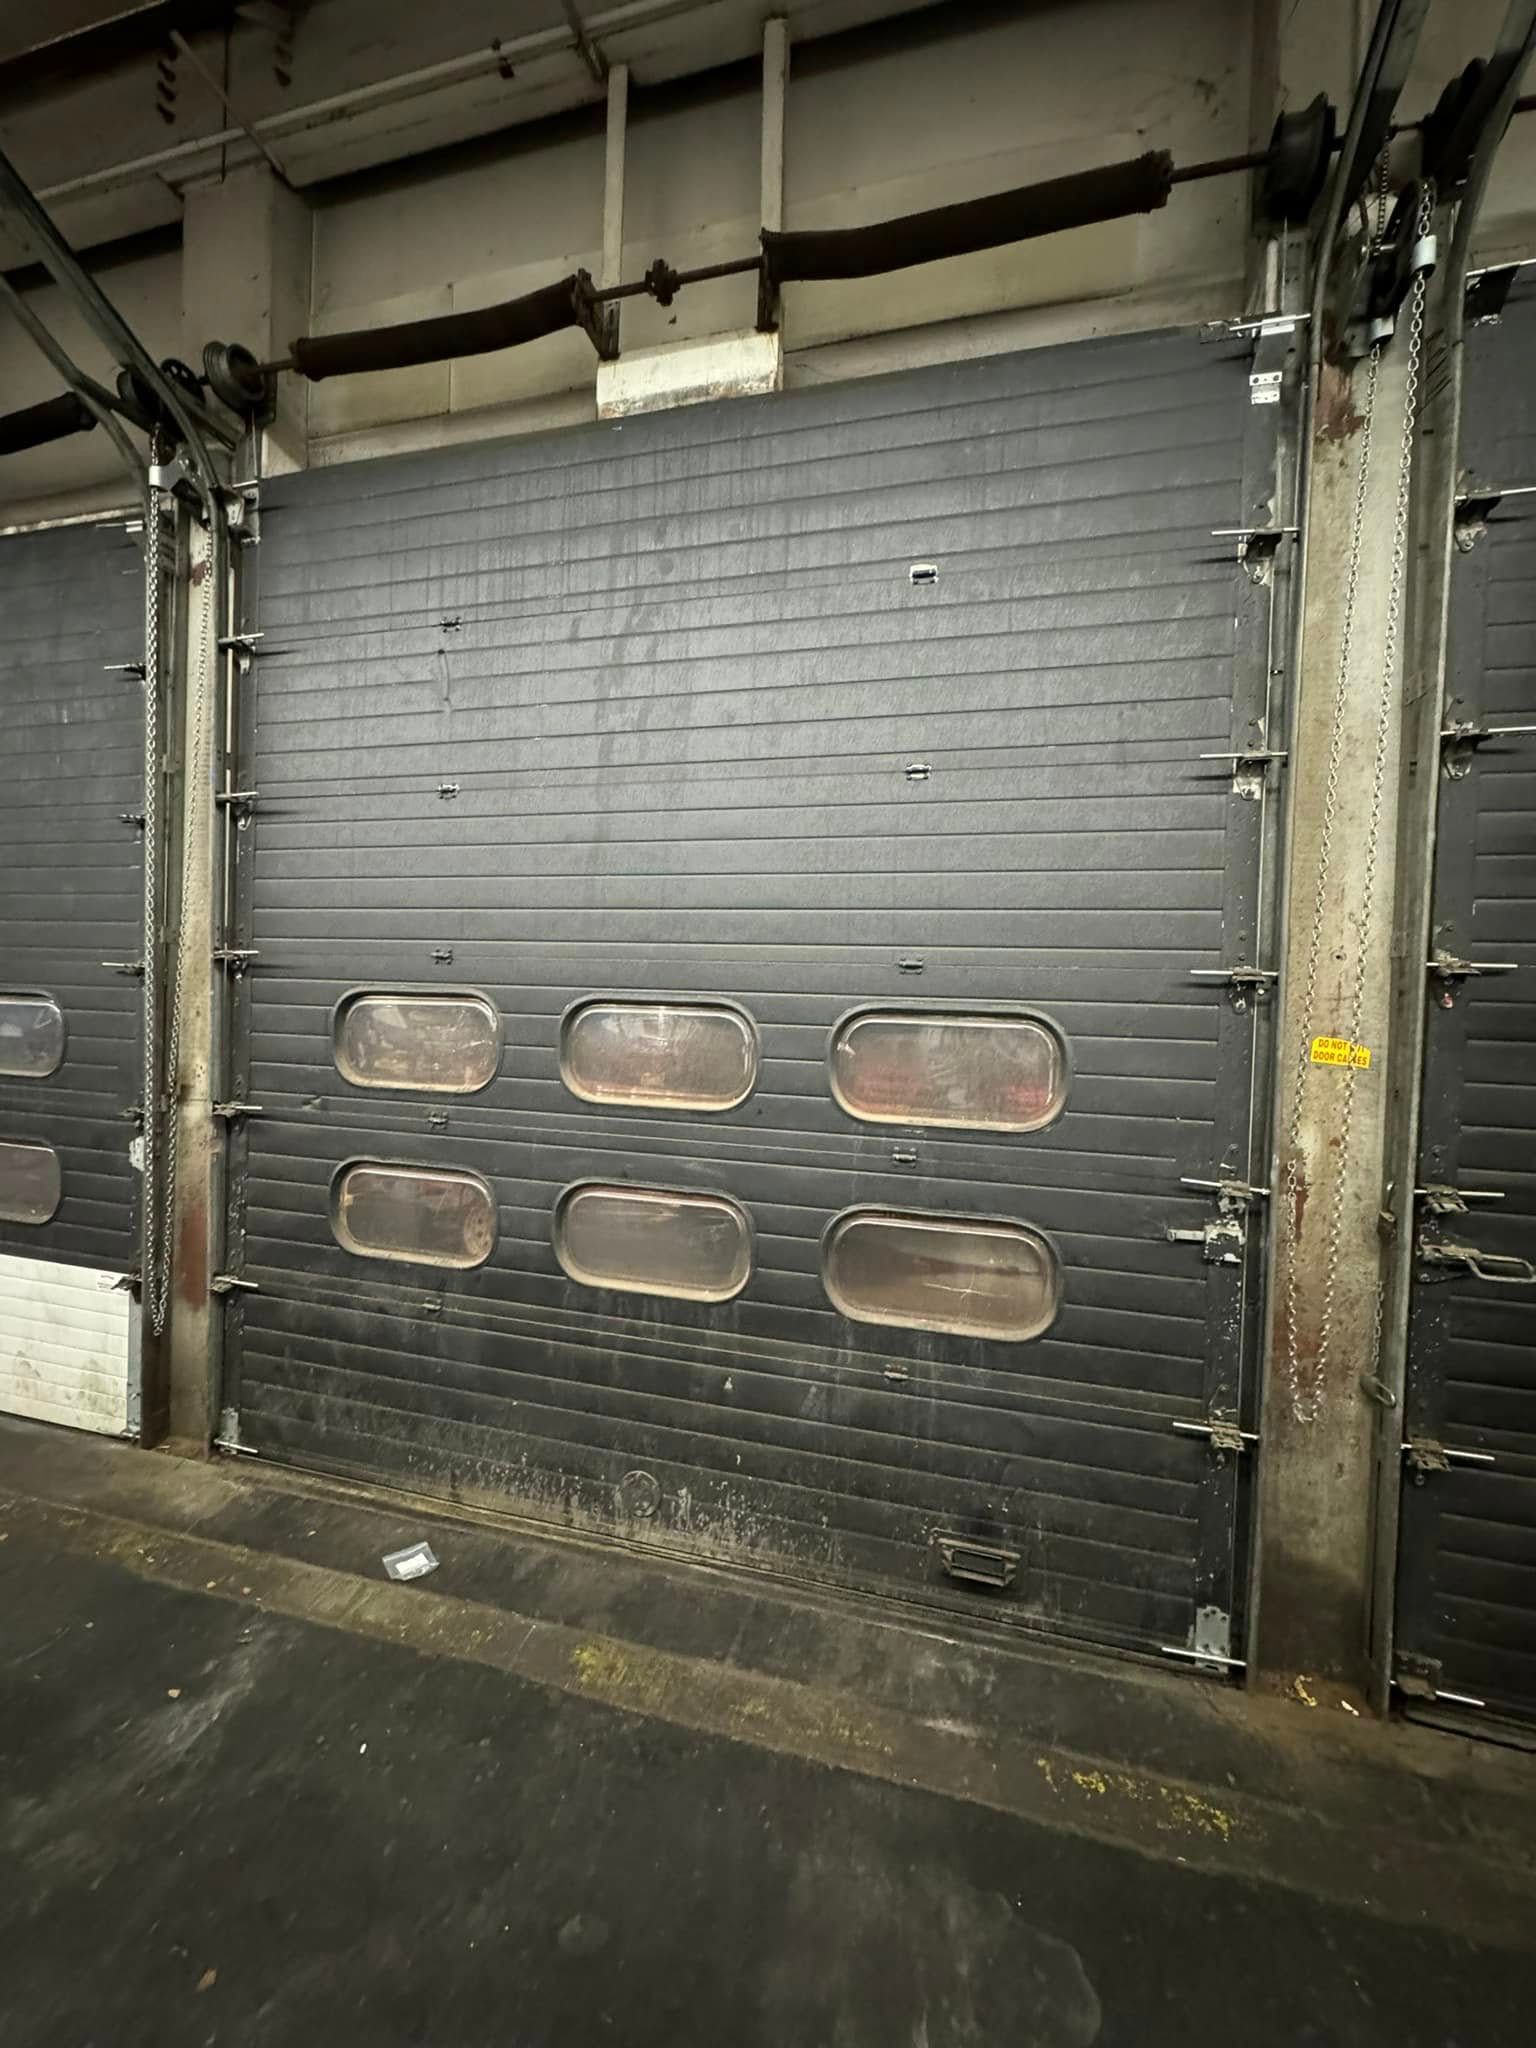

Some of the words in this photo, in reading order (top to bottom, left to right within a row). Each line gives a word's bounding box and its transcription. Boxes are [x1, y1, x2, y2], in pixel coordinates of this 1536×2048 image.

[1318, 1039, 1329, 1048] DO
[1331, 1040, 1348, 1050] NOT
[1313, 1050, 1335, 1061] DOOR
[1337, 1053, 1367, 1065] CAES
